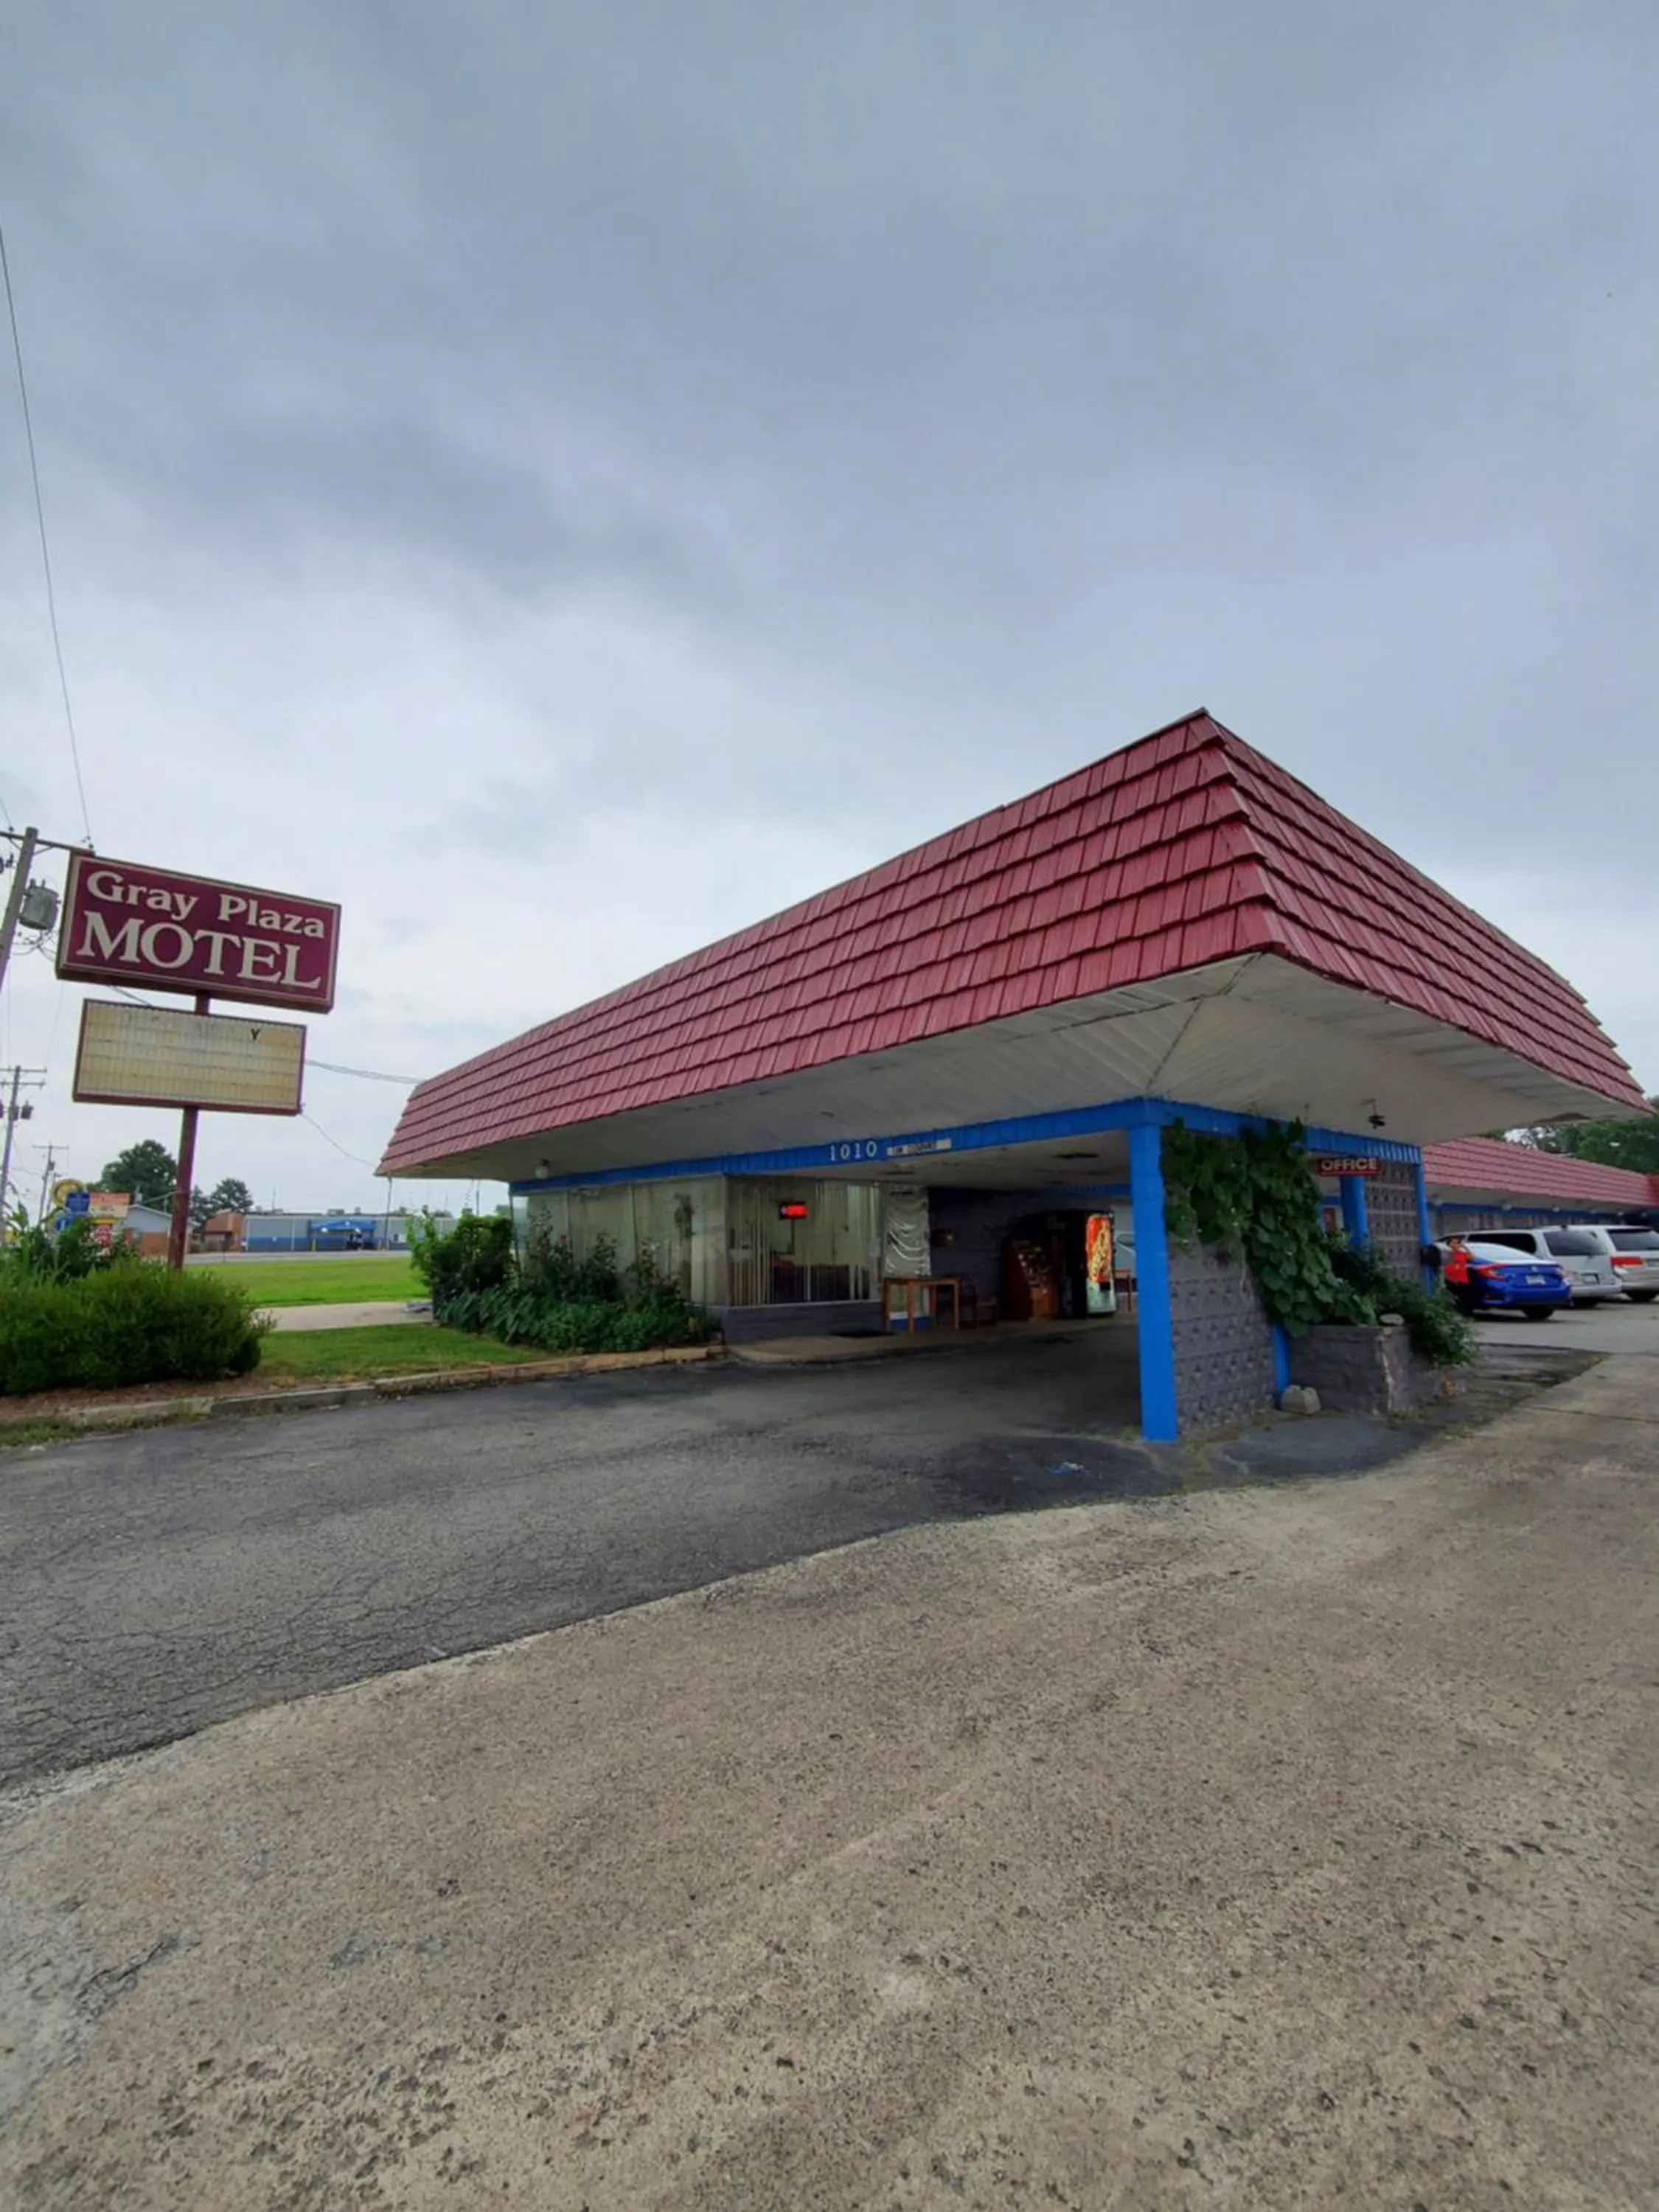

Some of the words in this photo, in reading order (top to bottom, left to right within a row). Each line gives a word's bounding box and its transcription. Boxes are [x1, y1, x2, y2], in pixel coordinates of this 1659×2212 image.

[86, 870, 199, 921] Gray
[218, 894, 325, 939] Plaza
[76, 910, 321, 990] MOTEL
[830, 1140, 878, 1162] 1010
[1321, 1157, 1378, 1172] OFFICE
